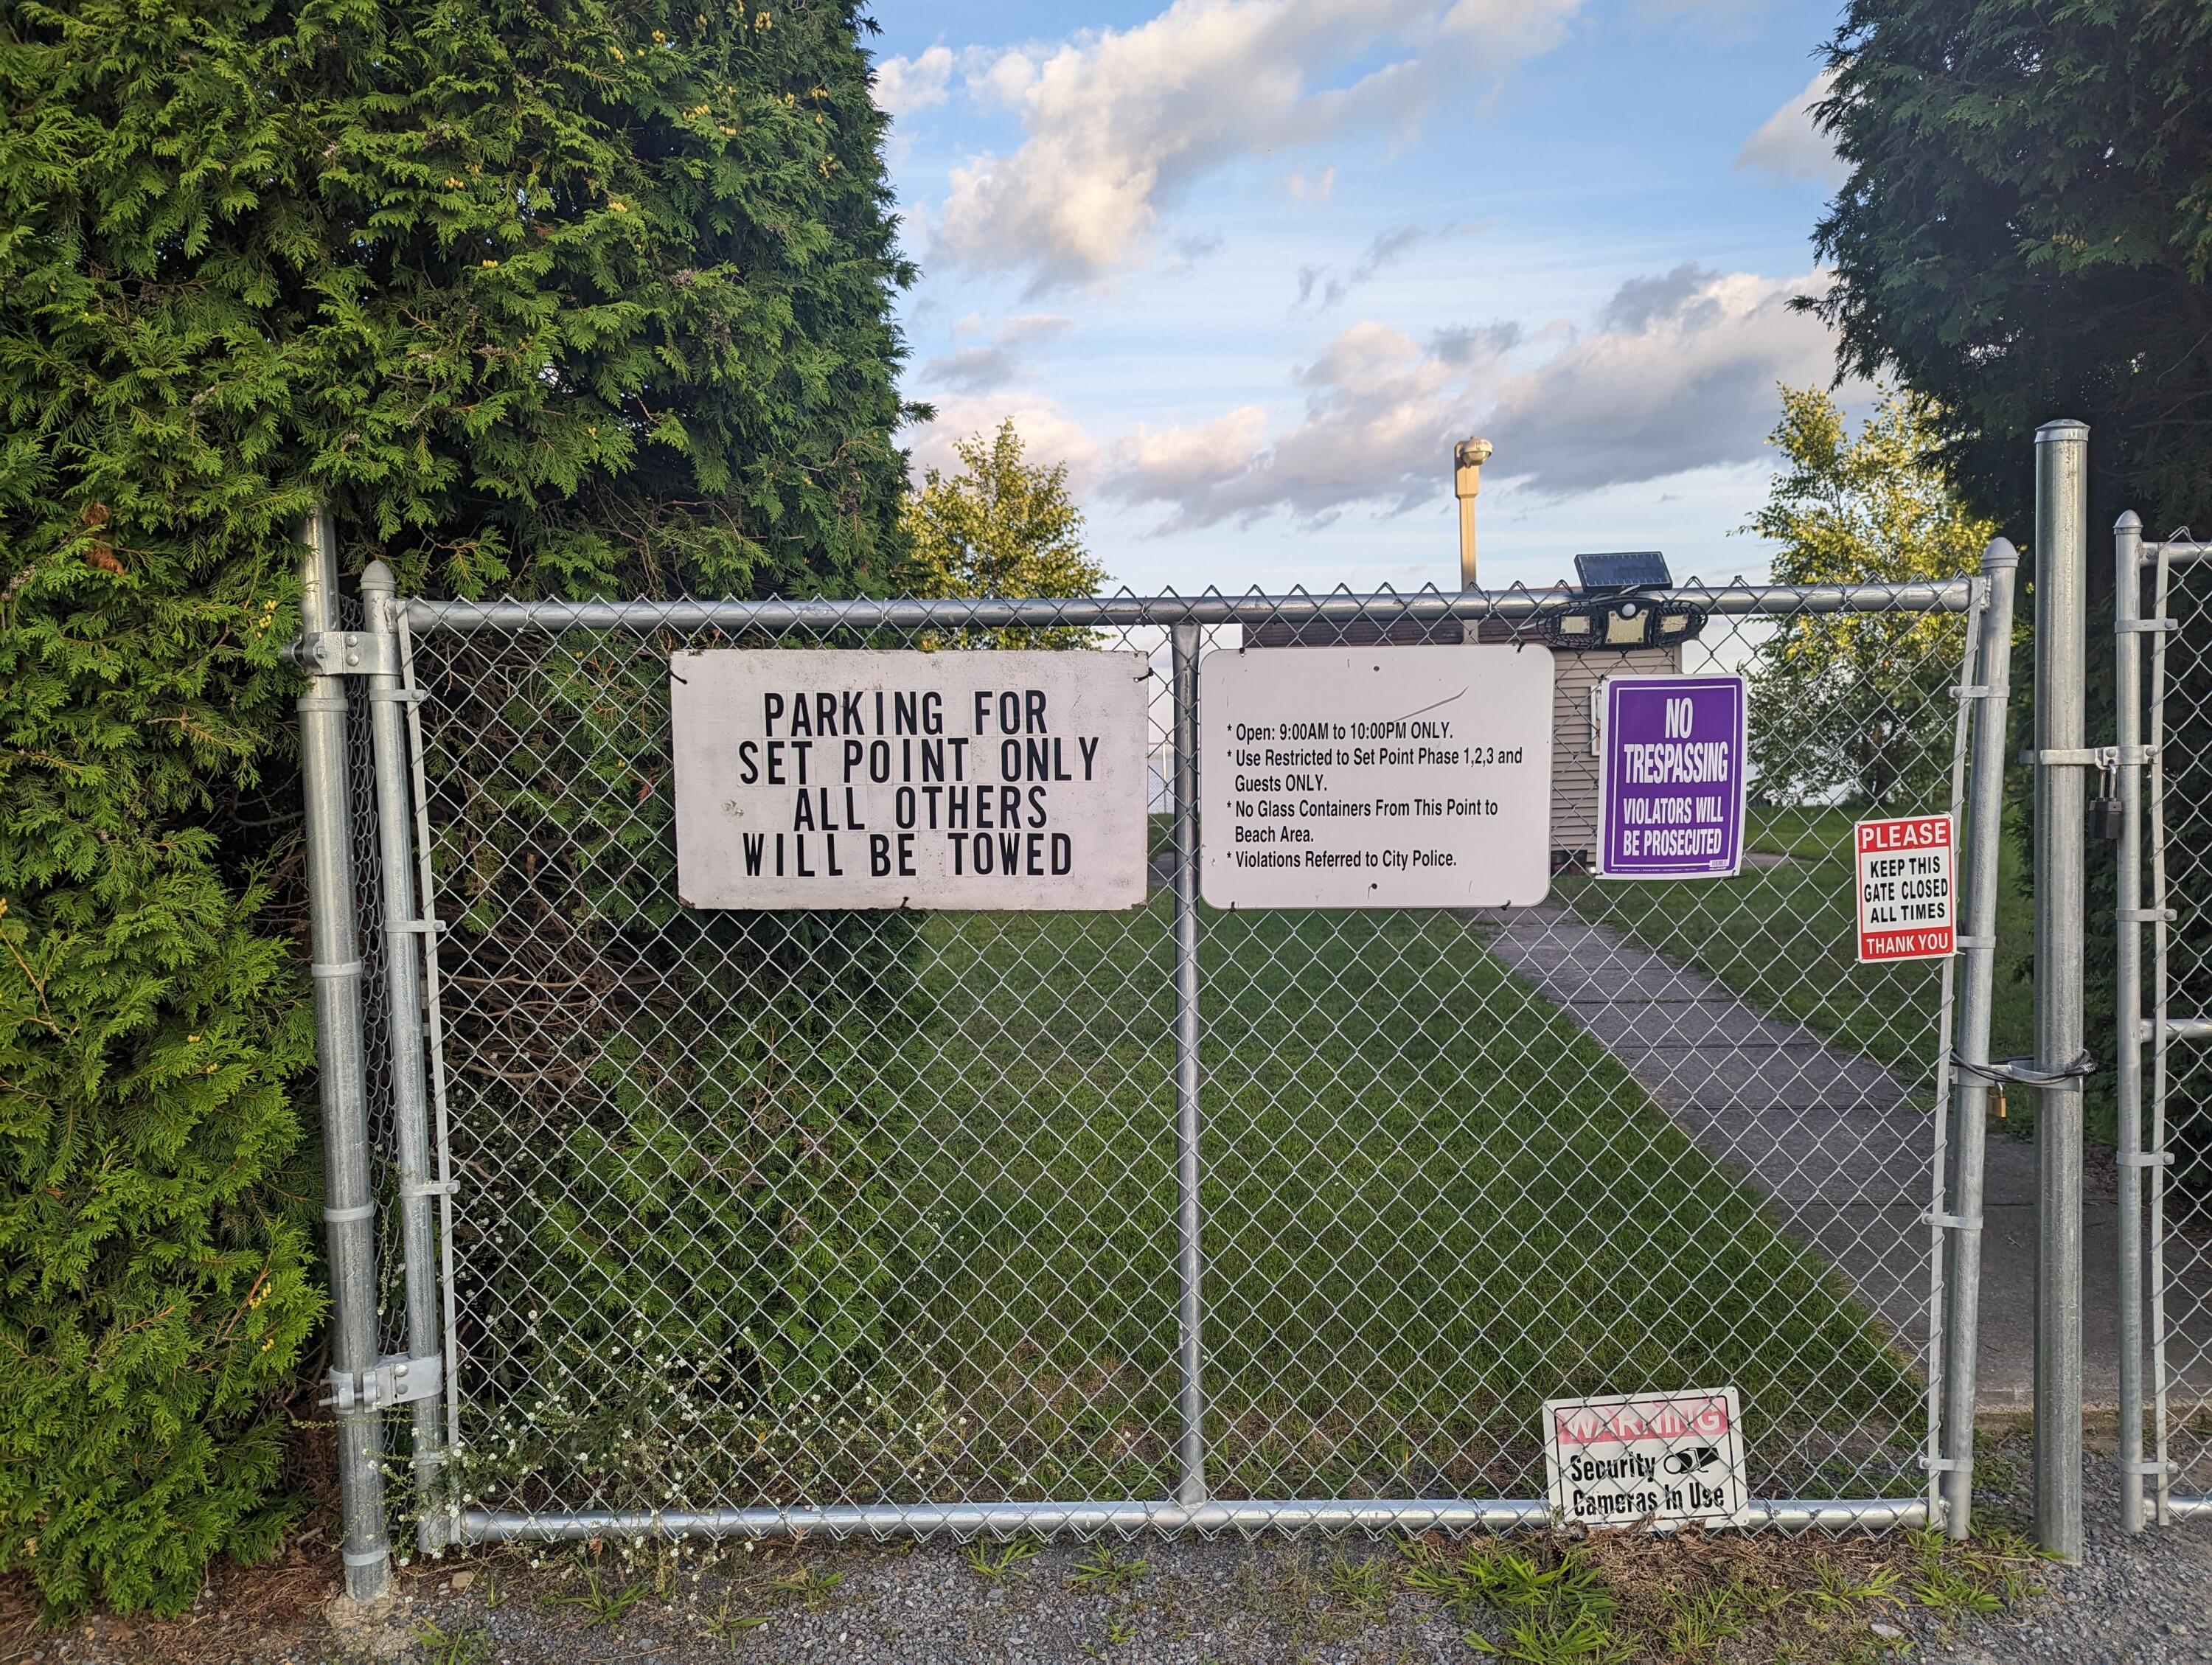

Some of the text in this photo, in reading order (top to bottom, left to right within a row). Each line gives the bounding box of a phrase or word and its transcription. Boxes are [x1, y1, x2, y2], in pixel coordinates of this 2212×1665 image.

[765, 689, 1048, 737] PARKING FOR
[1666, 698, 1693, 739] NO
[1236, 721, 1453, 744] Open: 9:00AM to 10:00PM ONLY.
[739, 737, 1099, 785] SET POINT ONLY
[1236, 747, 1523, 767] Use Restricted to Set Point Phase 1,2,3 and
[1624, 742, 1728, 783] TRESPASSING
[1235, 774, 1327, 792] Guests ONLY.
[793, 785, 1047, 831] ALL OTHERS
[1236, 799, 1498, 817] No Glass Containers From This Point to
[1624, 796, 1723, 824] VIOLATORS WILL
[1235, 825, 1314, 843] Beach Area.
[1623, 829, 1721, 855] BE PROSECUTED
[1862, 822, 1947, 849] PLEASE
[742, 832, 1071, 877] WILL BE TOWED
[1236, 849, 1457, 871] Violations Referred to City Police.
[1871, 856, 1940, 878] KEEP THIS
[1865, 878, 1948, 903] GATE CLOSED
[1871, 903, 1945, 923] ALL TIMES
[1866, 933, 1948, 954] THANK YOU
[1560, 1402, 1720, 1439] WARNING
[1571, 1451, 1655, 1483] Security
[1573, 1482, 1724, 1516] Cameras In Use
